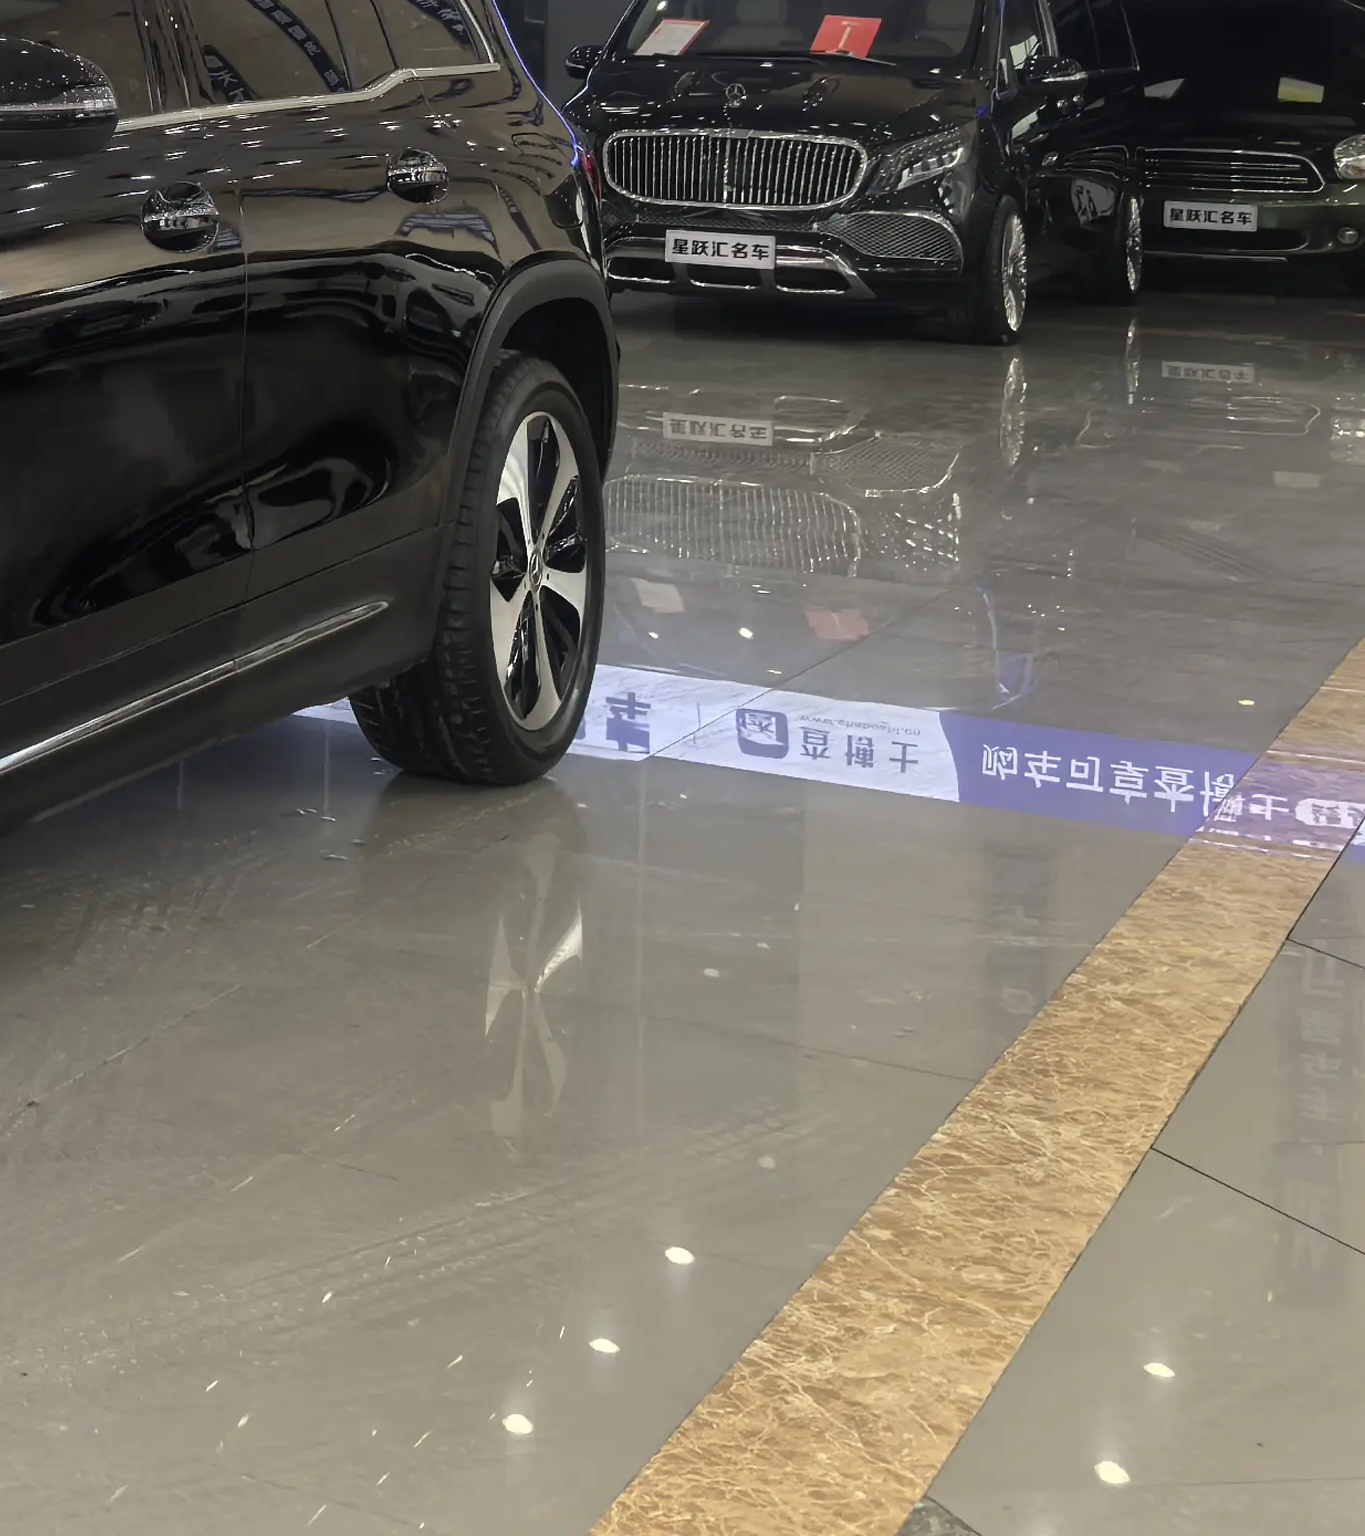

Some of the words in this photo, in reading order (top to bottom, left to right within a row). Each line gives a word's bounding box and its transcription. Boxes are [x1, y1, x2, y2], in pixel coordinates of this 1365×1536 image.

[1170, 208, 1252, 225] 星跃汇名车
[672, 238, 770, 260] 星跃汇名车
